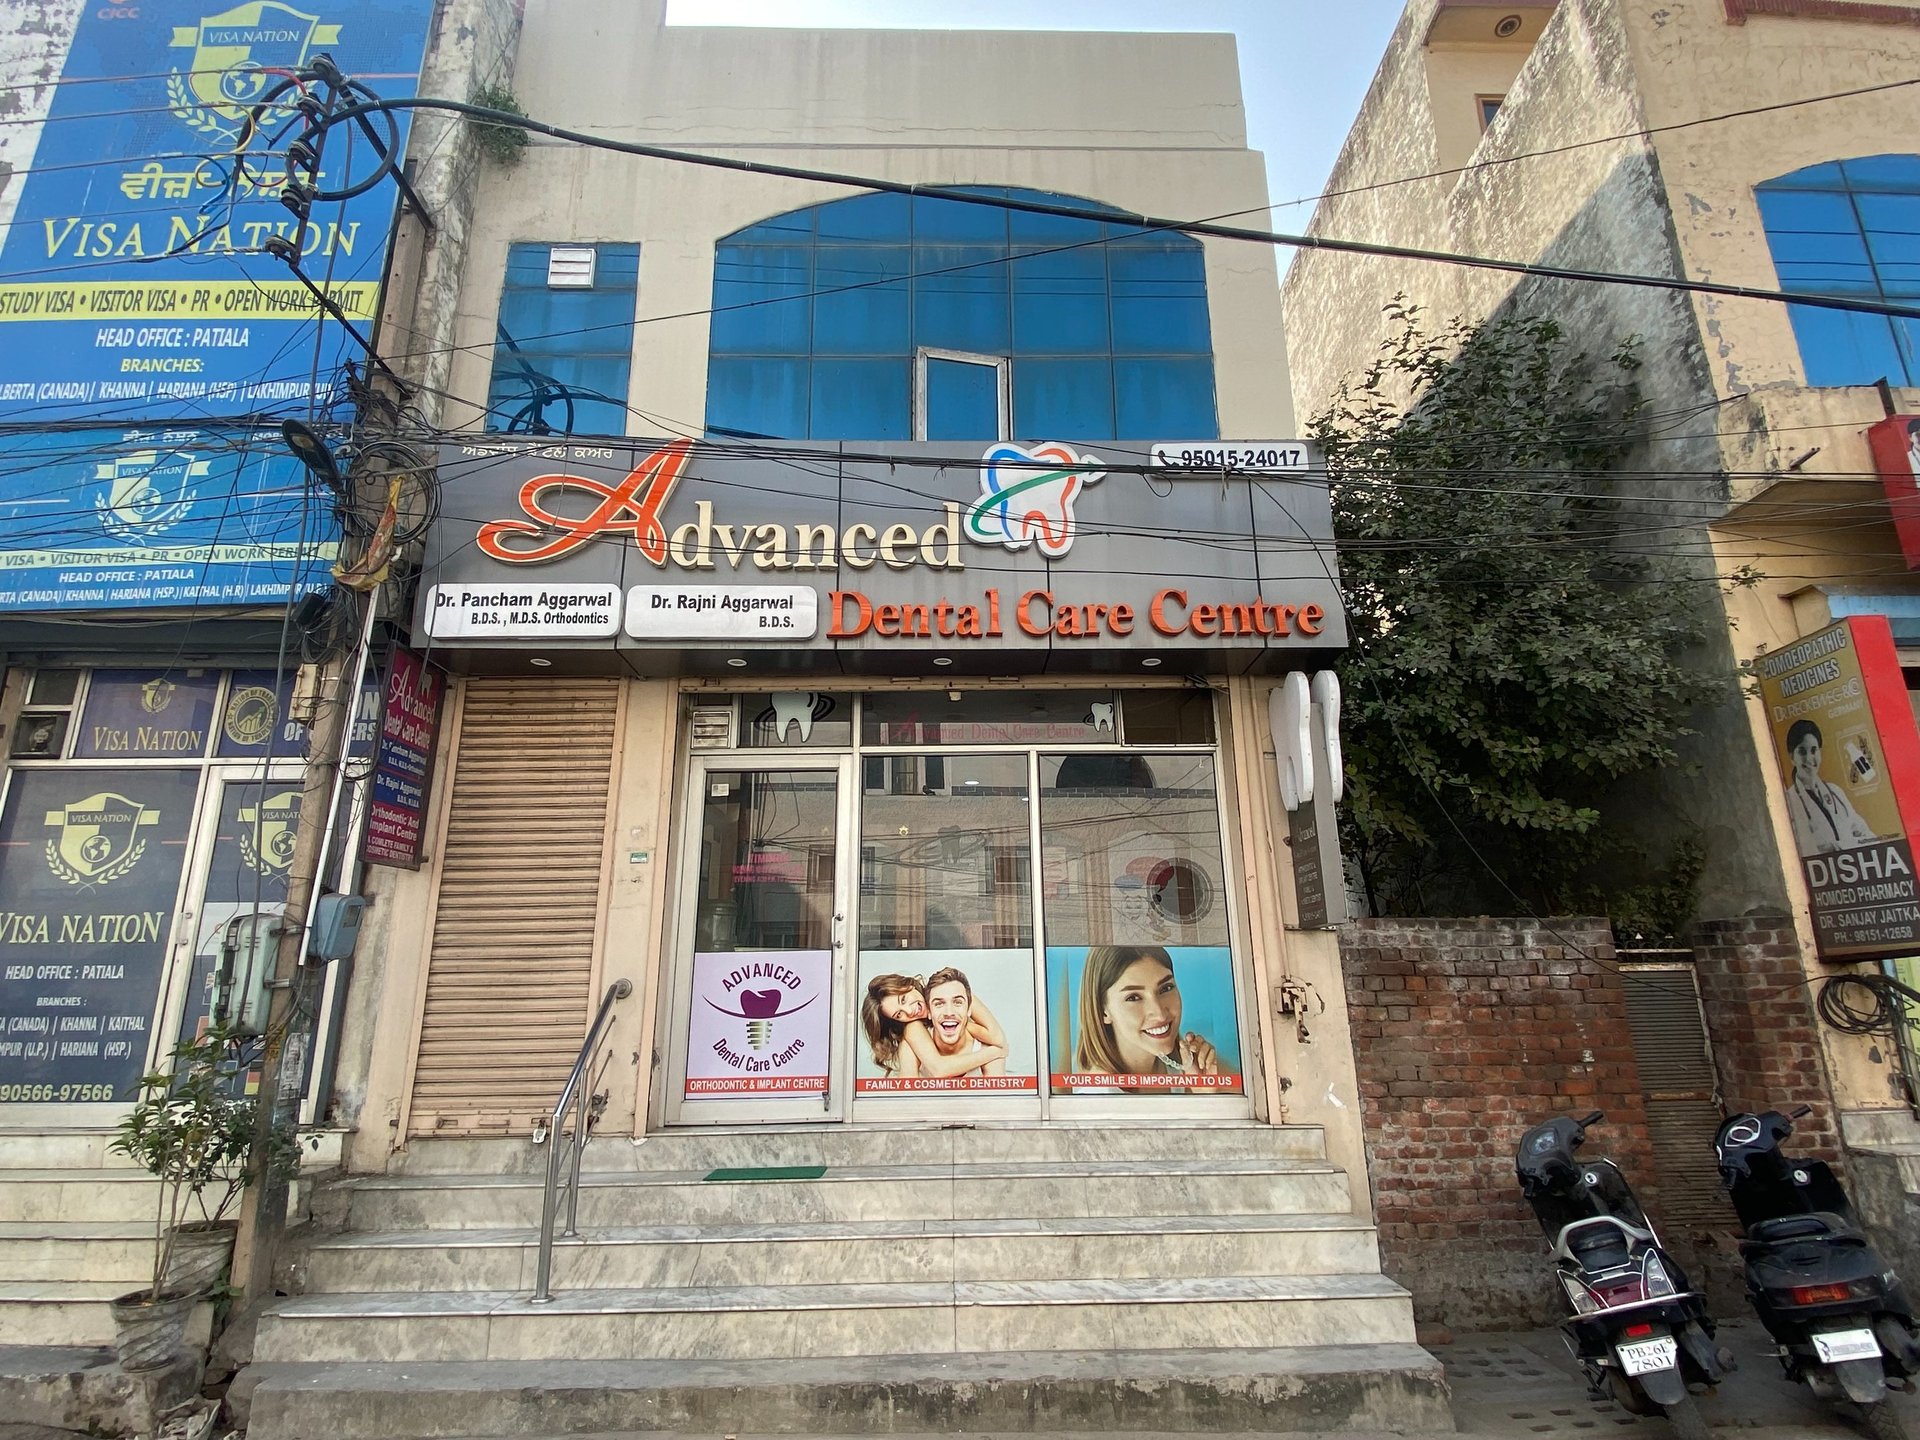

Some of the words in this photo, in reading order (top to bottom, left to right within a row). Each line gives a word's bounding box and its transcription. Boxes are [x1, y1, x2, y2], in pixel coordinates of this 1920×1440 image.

[209, 31, 239, 43] VISA
[241, 30, 299, 43] NATION
[43, 217, 145, 259] VISA
[167, 215, 361, 257] NATION
[44, 290, 74, 312] VISA
[90, 290, 142, 312] VISITOR
[147, 289, 176, 312] VISA
[191, 289, 209, 312] PR
[223, 289, 262, 312] OPEN
[264, 289, 308, 312] WORK
[95, 328, 132, 348] HEAD
[136, 328, 182, 348] OFFICE
[192, 328, 249, 348] PATIALA
[120, 359, 205, 374] BRANCHES:
[1180, 449, 1301, 467] 95015-24017
[121, 467, 142, 476] VISA
[476, 437, 965, 570] Advanced
[6, 555, 35, 566] VISA
[51, 553, 101, 565] VISITOR
[107, 552, 137, 565] VISA
[152, 550, 169, 562] PR
[183, 548, 220, 562] OPEN
[226, 547, 266, 560] WORK
[59, 571, 92, 583] HEAD
[95, 570, 136, 582] OFFICE
[144, 568, 195, 581] PATIALA
[250, 583, 303, 597] LAKHIMPR
[435, 592, 457, 609] Dr.
[460, 592, 534, 609] Pancham
[537, 592, 612, 611] Aggarwal
[650, 594, 673, 610] Dr.
[676, 594, 717, 612] Rajni
[720, 595, 794, 613] Aggarwal
[470, 612, 501, 626] B.D.S.
[508, 612, 541, 626] M.D.S.
[543, 611, 609, 626] Orthodontics
[758, 615, 795, 629] B.D.S.
[827, 588, 1004, 640] Dental
[1017, 589, 1135, 639] Care
[1148, 588, 1326, 637] Centre
[1780, 657, 1841, 699] MEDICINES
[93, 726, 129, 751] VISA
[134, 726, 203, 751] NATION
[283, 722, 304, 742] OF
[71, 814, 93, 824] VISA
[94, 813, 132, 824] NATION
[261, 812, 280, 821] VISA
[396, 825, 417, 842] Centre
[1806, 846, 1911, 888] DISHA
[1815, 887, 1856, 907] HOMOEO
[1857, 879, 1915, 903] PHARMACY
[0, 912, 50, 944] VISA
[58, 911, 165, 944] NATION
[1819, 915, 1837, 929] DR.
[1838, 910, 1877, 927] SANJAY
[5, 965, 34, 980] HEAD
[36, 965, 73, 980] OFFICE
[81, 964, 125, 980] PATIALA
[721, 963, 802, 993] ADVANCED
[36, 996, 81, 1007] BRANCHES
[7, 1015, 50, 1035] (CANADA)
[60, 1016, 97, 1032] KHANNA
[107, 1016, 146, 1031] KAITHAL
[59, 1041, 99, 1057] HARIANA
[104, 1041, 132, 1061] (HSP.)
[712, 1037, 746, 1070] Dental
[745, 1056, 771, 1072] Care
[771, 1038, 806, 1068] Centre
[690, 1079, 748, 1091] ORTHODONTIC
[749, 1080, 755, 1090] &
[757, 1079, 792, 1090] IMPLANT
[793, 1078, 825, 1089] CENTRE
[865, 1080, 901, 1091] FAMILY
[903, 1080, 911, 1090] &
[914, 1079, 963, 1090] COSMETIC
[965, 1078, 1026, 1089] DENTISTRY
[1061, 1075, 1090, 1087] YOUR
[1091, 1075, 1125, 1087] SMILE
[1127, 1075, 1135, 1086] IS
[1137, 1075, 1199, 1087] IMPORTANT
[1200, 1075, 1215, 1086] TO
[1217, 1075, 1232, 1086] US
[1632, 1355, 1673, 1372] 7801
